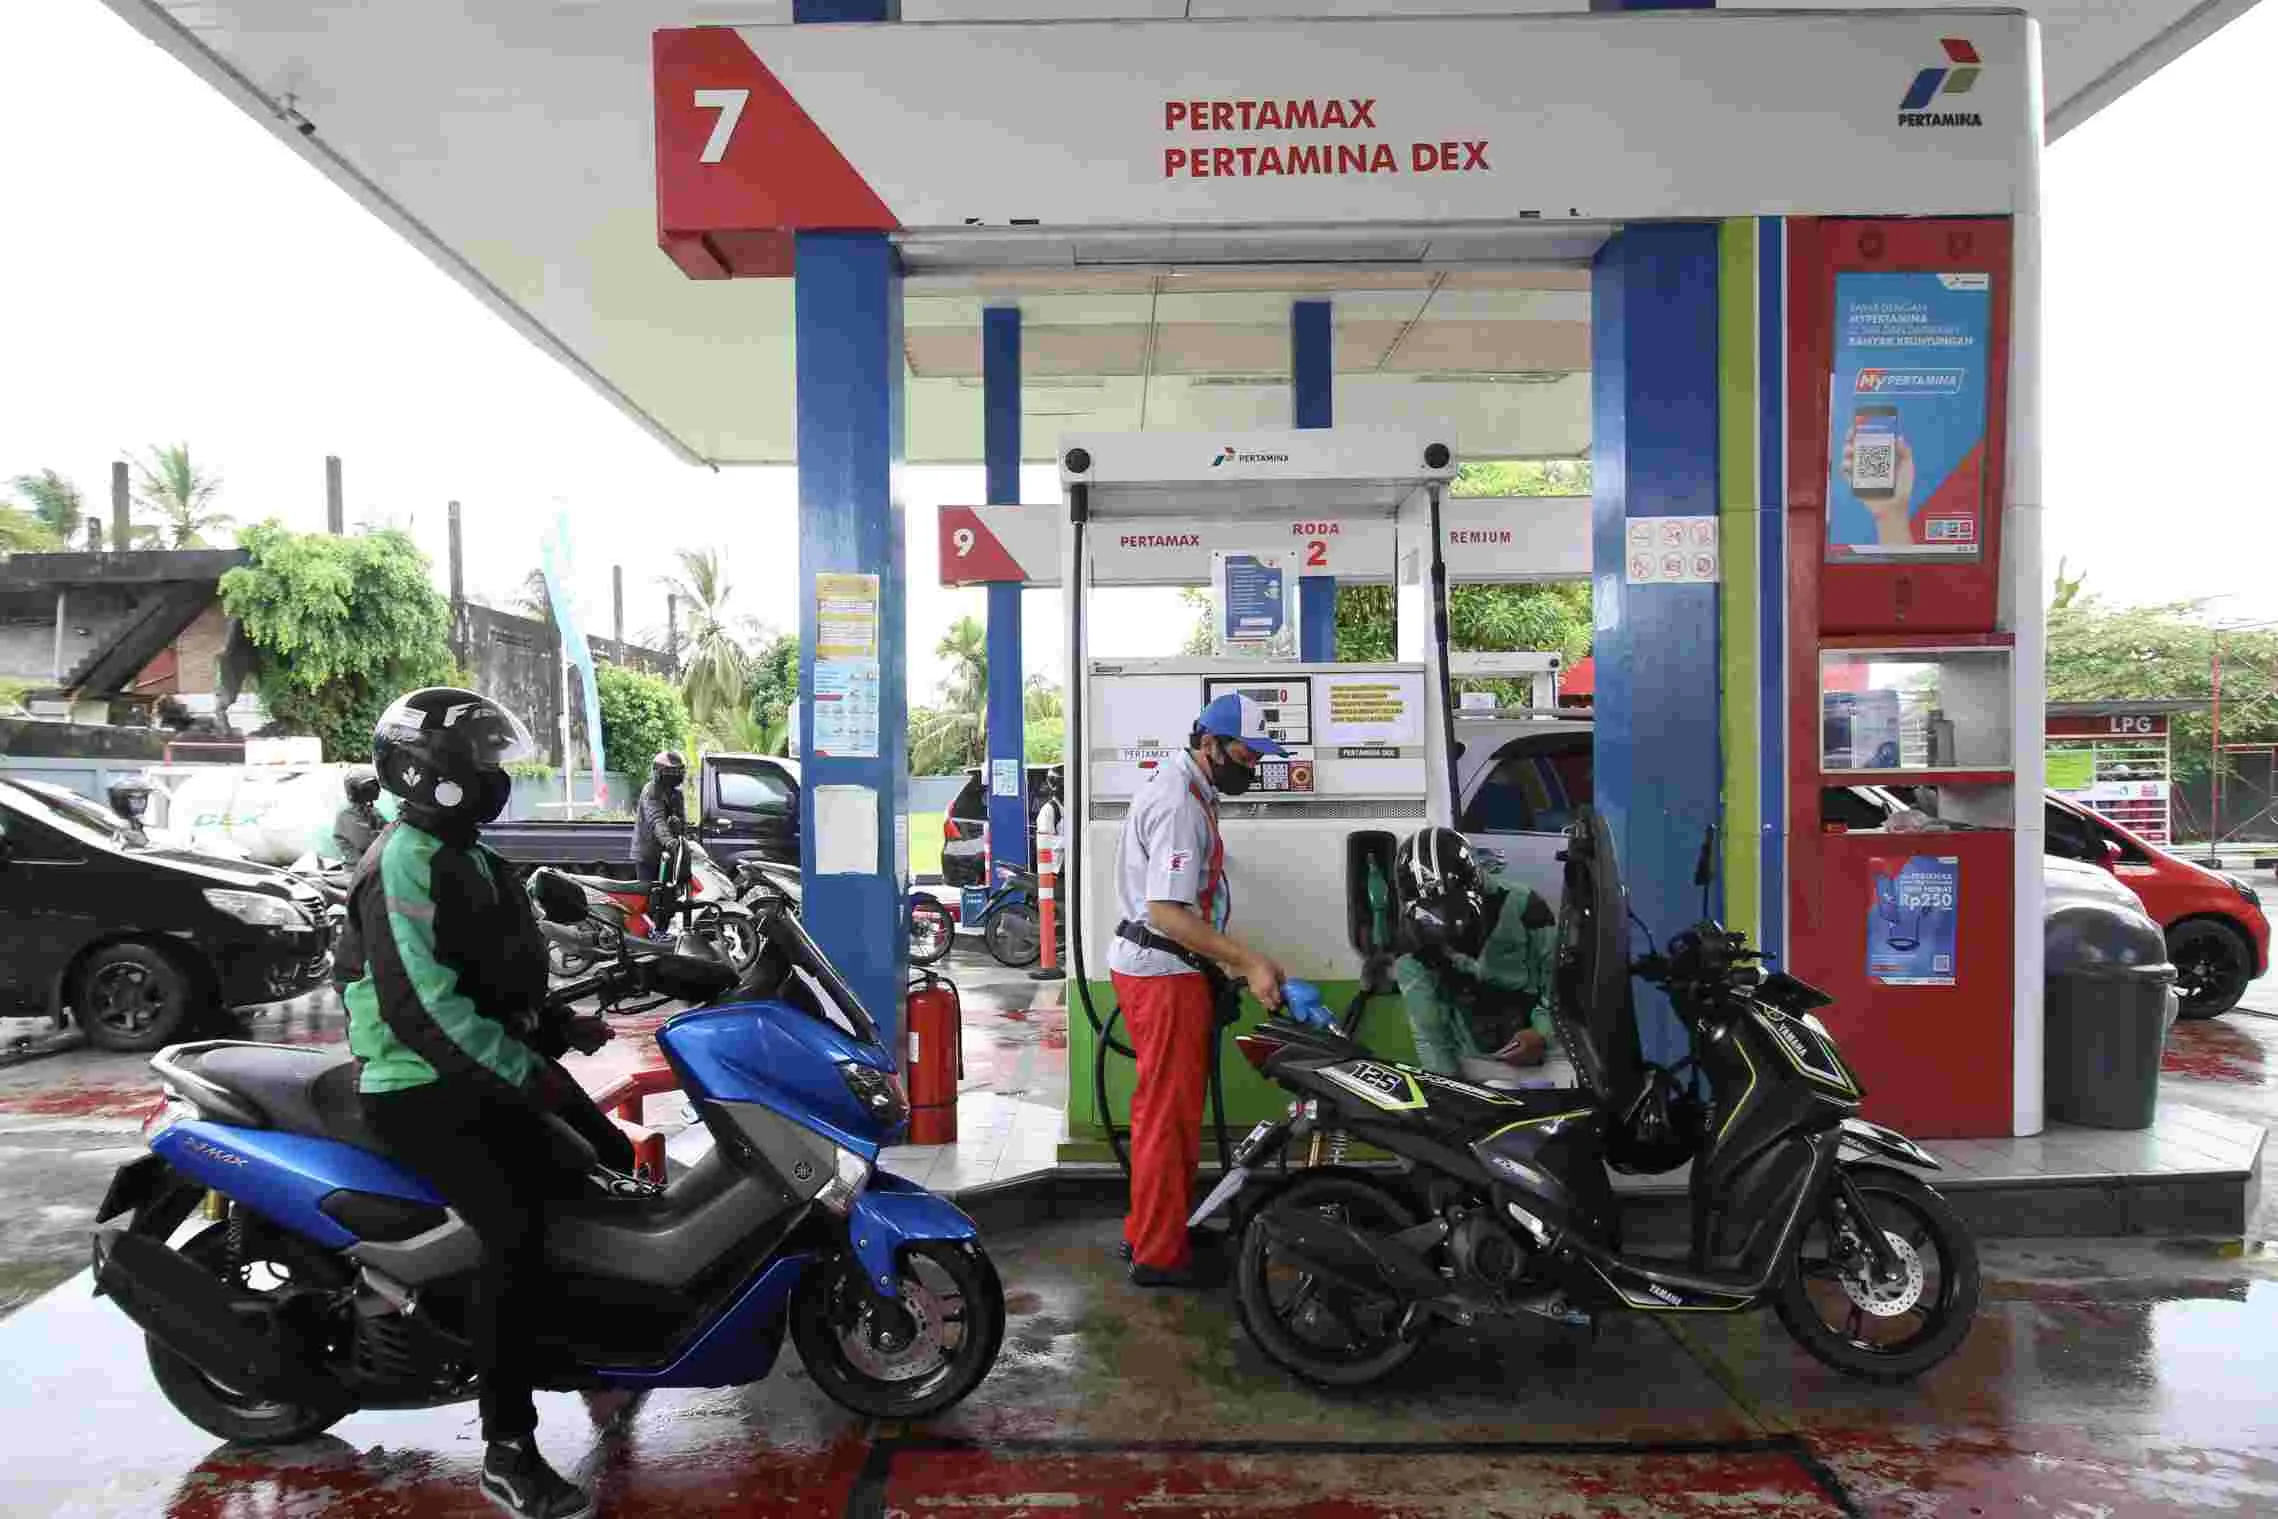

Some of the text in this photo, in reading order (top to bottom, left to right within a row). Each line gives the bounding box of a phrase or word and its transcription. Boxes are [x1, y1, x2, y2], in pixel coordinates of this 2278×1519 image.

[1165, 99, 1376, 131] PERTAMAX
[1898, 113, 1982, 127] PERTAMINA
[693, 89, 750, 163] 7
[1165, 141, 1490, 178] PERTAMINA DEX
[1239, 454, 1289, 463] PERTAMINA
[1292, 523, 1340, 535] RODA
[1450, 531, 1512, 544] REMIUM
[953, 528, 975, 557] 9
[1120, 535, 1200, 547] PERTAMAX
[1307, 541, 1327, 566] 2
[2110, 716, 2152, 733] LPG
[1352, 1063, 1401, 1092] 125
